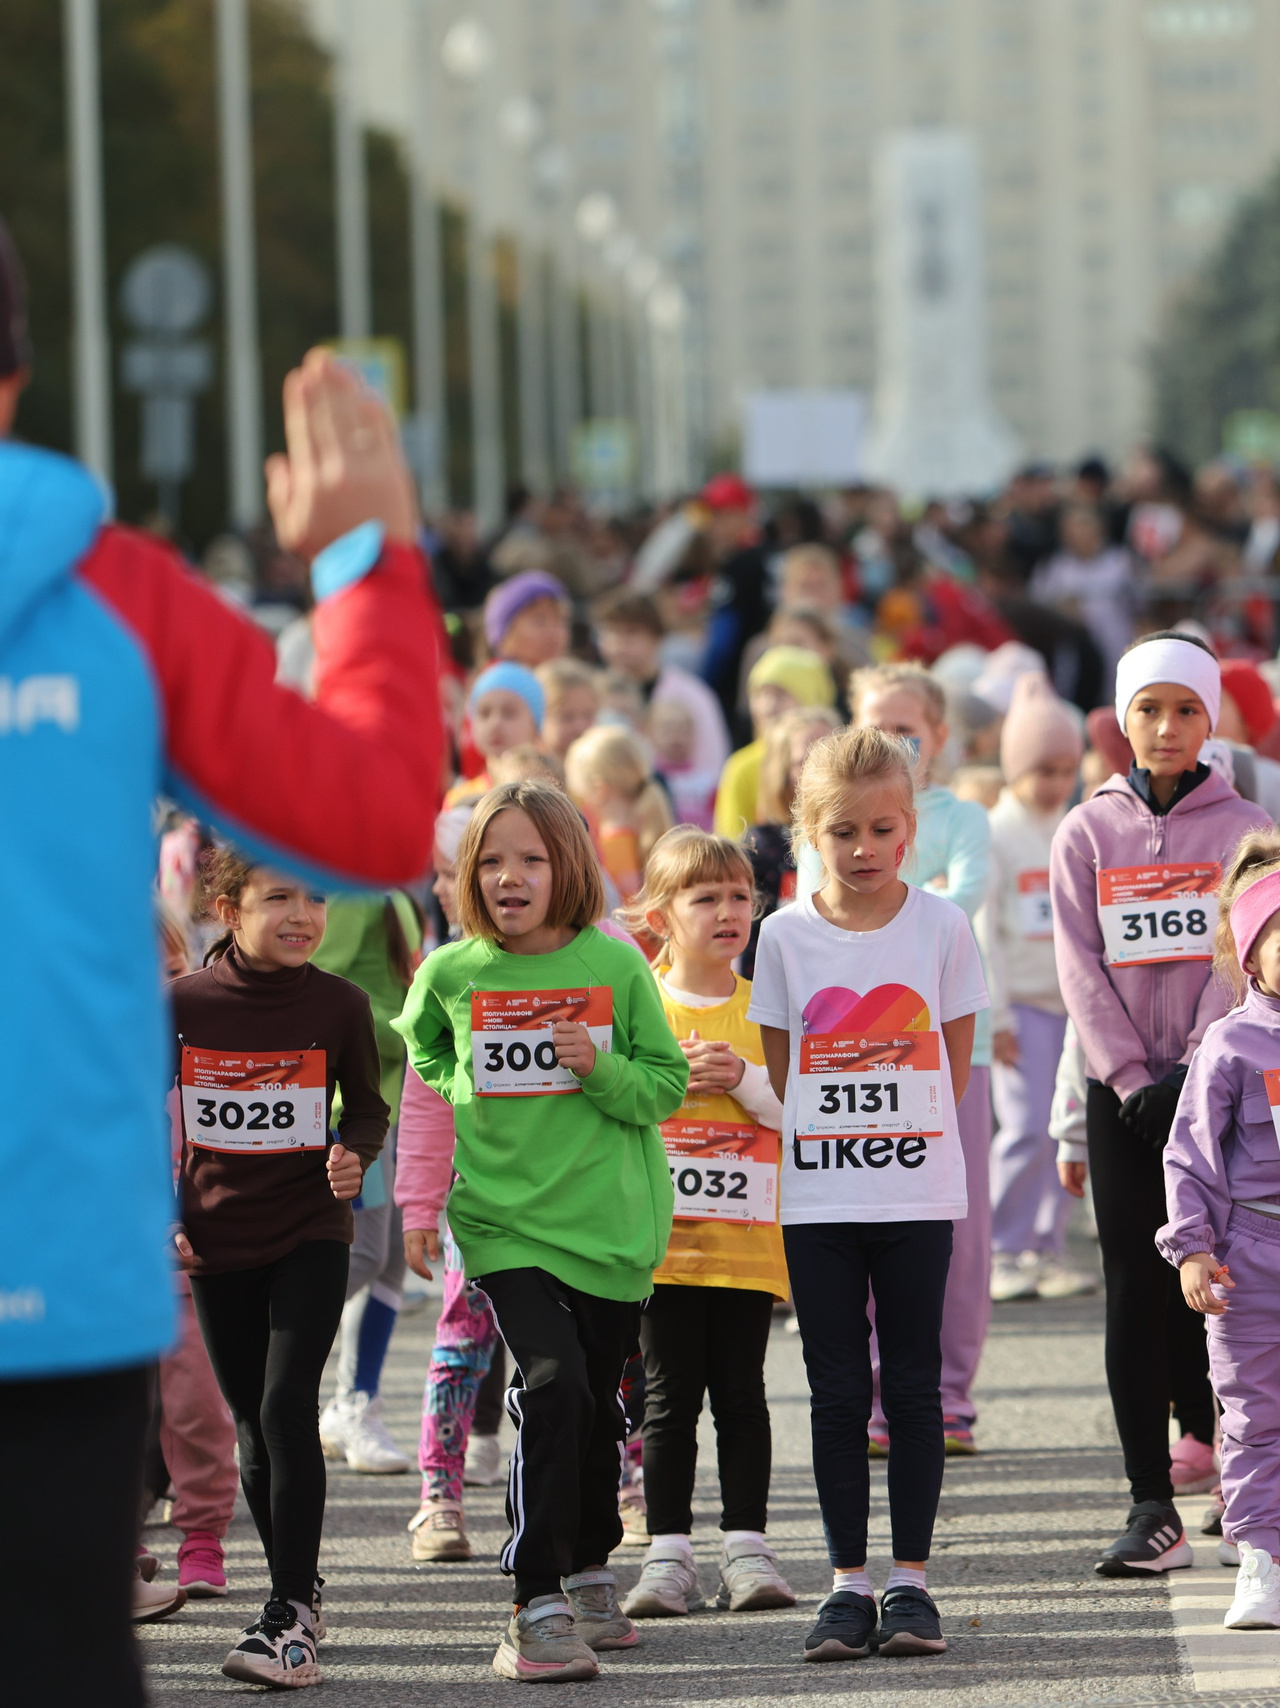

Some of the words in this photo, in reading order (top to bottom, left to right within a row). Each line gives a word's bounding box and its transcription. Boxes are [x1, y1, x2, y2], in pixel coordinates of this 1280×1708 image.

[1122, 909, 1207, 941] 3168
[484, 1041, 569, 1072] 300
[197, 1098, 295, 1130] 3028
[819, 1083, 899, 1114] 3131
